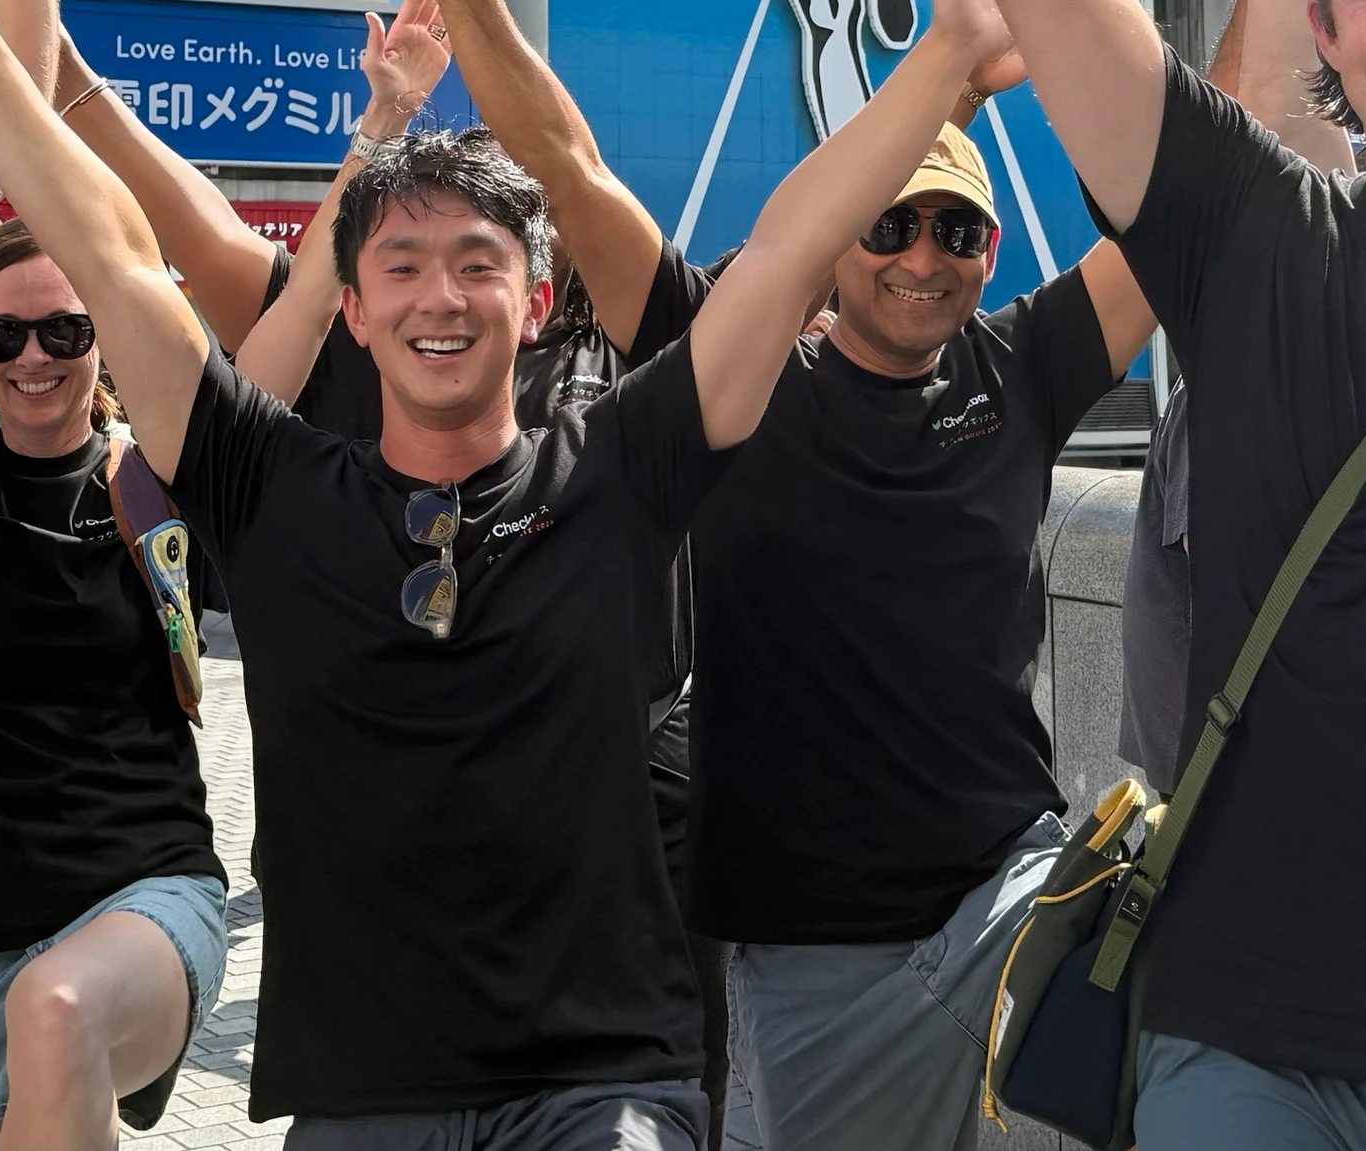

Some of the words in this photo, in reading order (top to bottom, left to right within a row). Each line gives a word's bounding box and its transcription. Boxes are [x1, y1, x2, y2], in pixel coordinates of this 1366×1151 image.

[115, 35, 176, 62] Love
[184, 39, 263, 65] Earth.
[275, 45, 328, 70] Love
